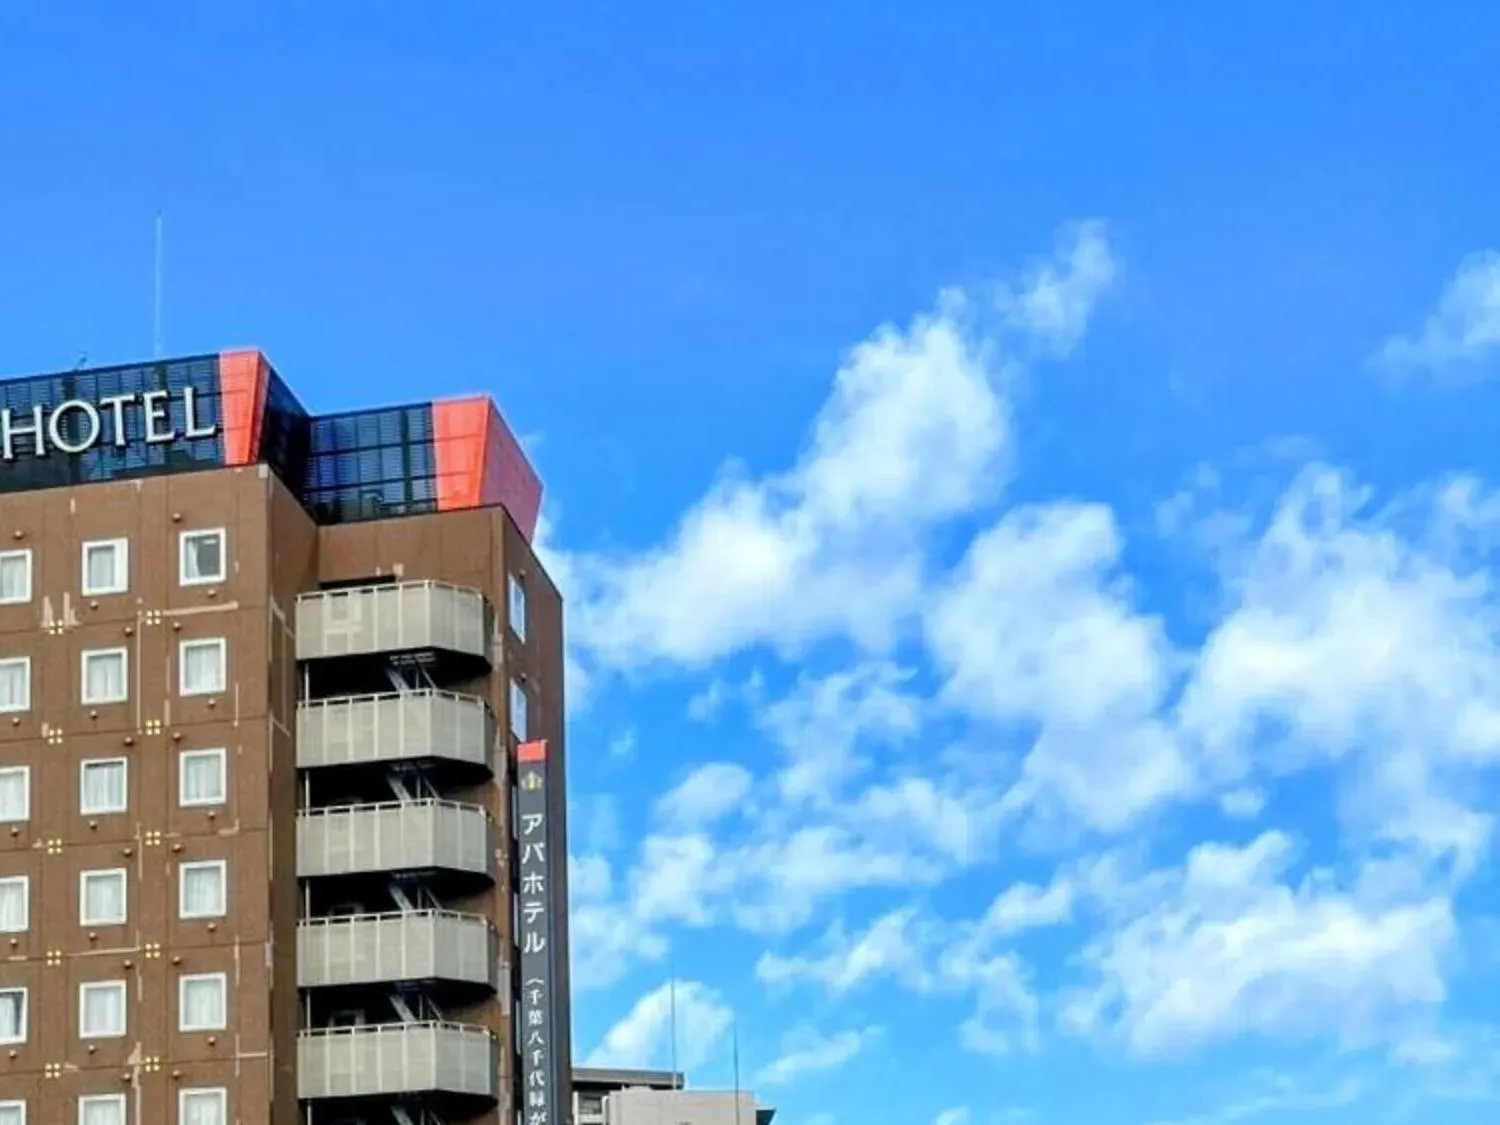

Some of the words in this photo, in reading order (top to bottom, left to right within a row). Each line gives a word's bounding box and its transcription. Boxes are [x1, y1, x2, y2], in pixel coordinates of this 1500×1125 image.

[1, 386, 216, 461] HOTEL
[521, 812, 546, 954] アパホテル
